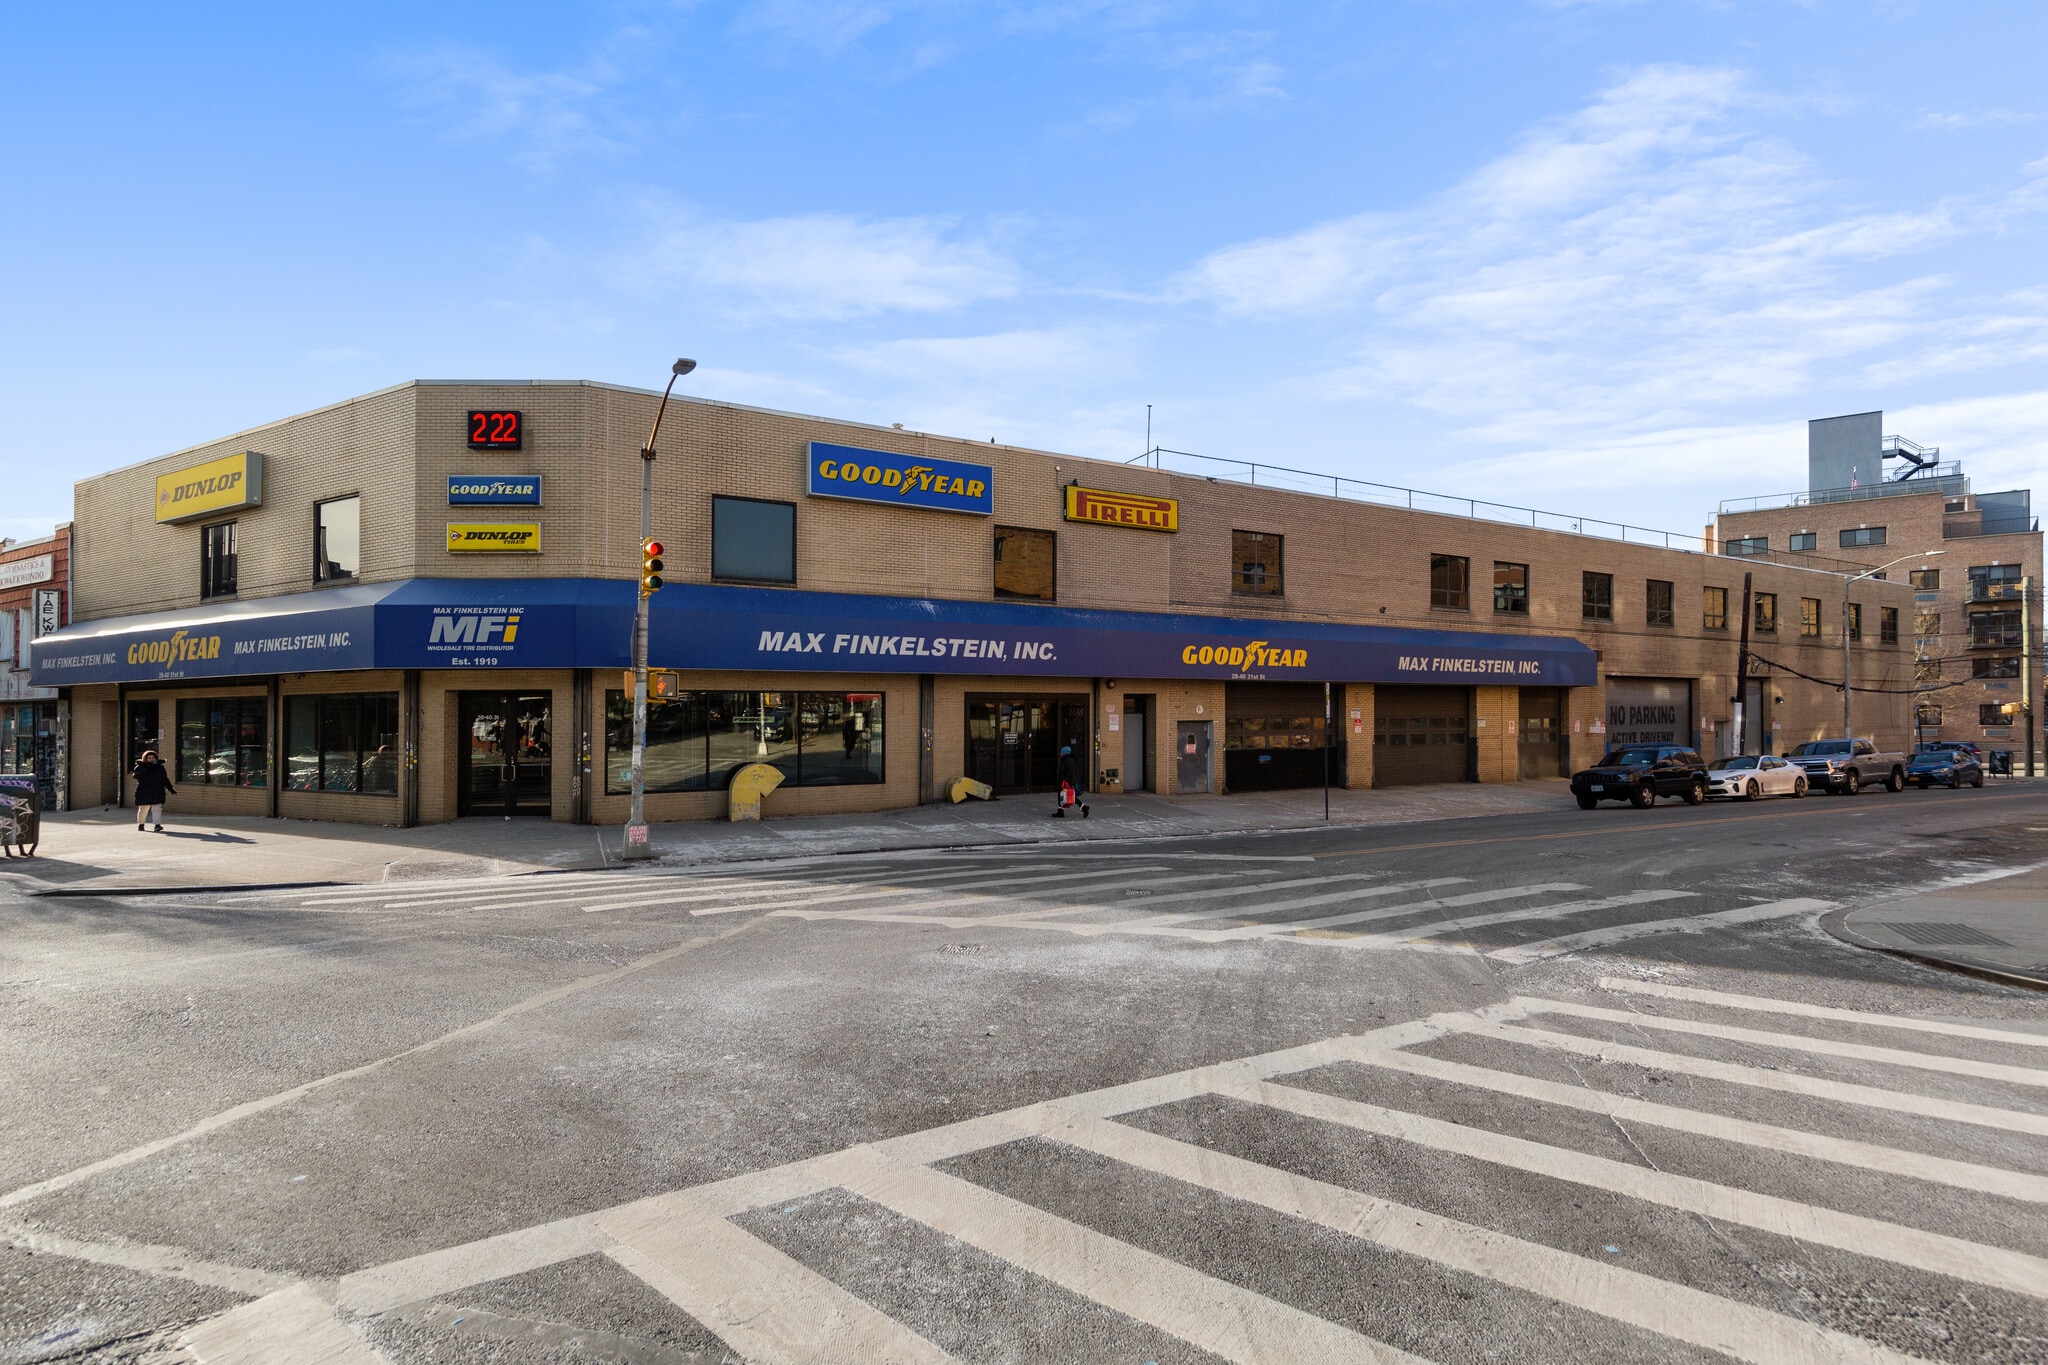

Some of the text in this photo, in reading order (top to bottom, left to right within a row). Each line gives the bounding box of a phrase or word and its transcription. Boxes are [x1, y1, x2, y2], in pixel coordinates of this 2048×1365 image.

[172, 472, 242, 502] DUNLOP
[450, 484, 533, 495] GOODYEAR
[819, 460, 986, 498] GOODYEAR
[1076, 490, 1171, 527] PIRELLI
[464, 531, 532, 540] DUNLOP
[43, 591, 54, 614] TAE
[429, 616, 520, 643] MFi
[127, 635, 221, 665] GOODYEAR
[234, 631, 351, 655] MAX FINKELSTEIN, INC.
[758, 631, 1057, 662] MAX FINKELSTEIN, INC.
[42, 658, 56, 670] MAX
[103, 652, 117, 664] INC.
[451, 657, 498, 666] Est. 1919
[1182, 644, 1308, 668] GOODYEAR
[1398, 656, 1541, 675] MAX FINKELSTEIN, INC.
[1610, 706, 1676, 726] NO PARKING
[1611, 731, 1675, 744] ACTIVE DRIVEWAY
